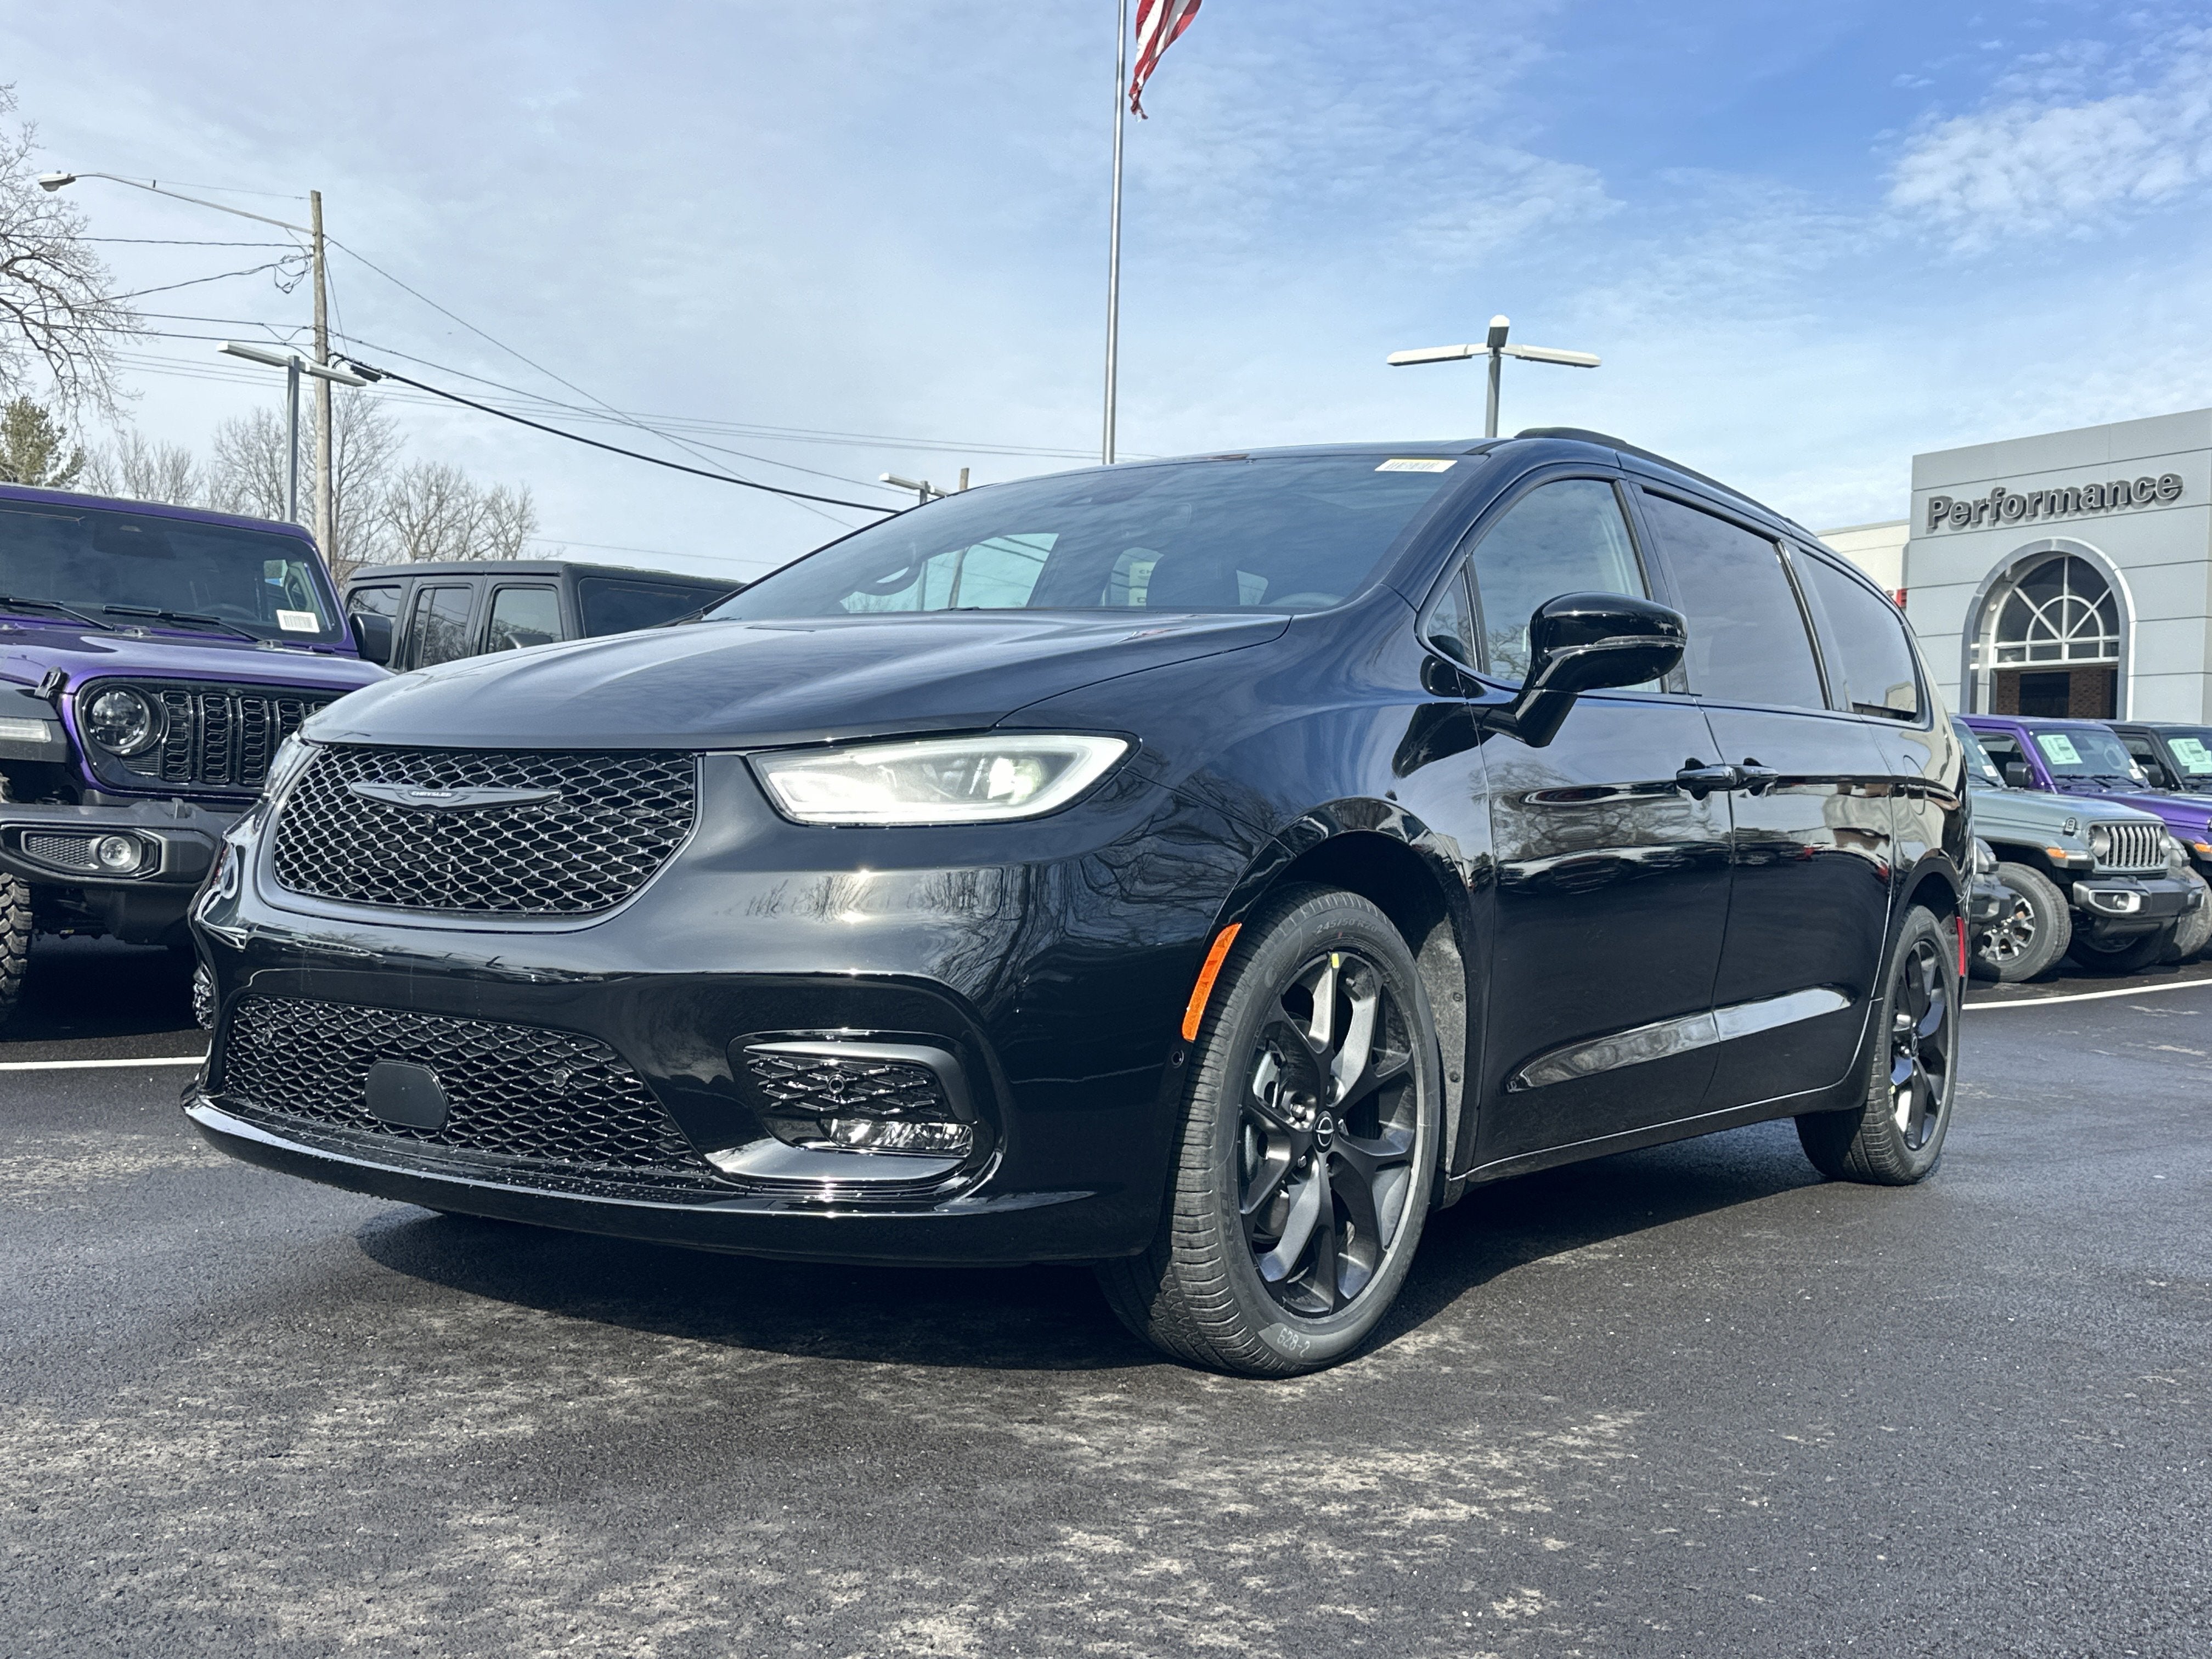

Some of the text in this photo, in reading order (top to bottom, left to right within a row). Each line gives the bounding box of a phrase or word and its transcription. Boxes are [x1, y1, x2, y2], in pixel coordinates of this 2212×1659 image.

[1927, 473, 2183, 529] Performance
[1317, 918, 1378, 934] 245/50 R20
[1277, 1327, 1311, 1358] 628-2
